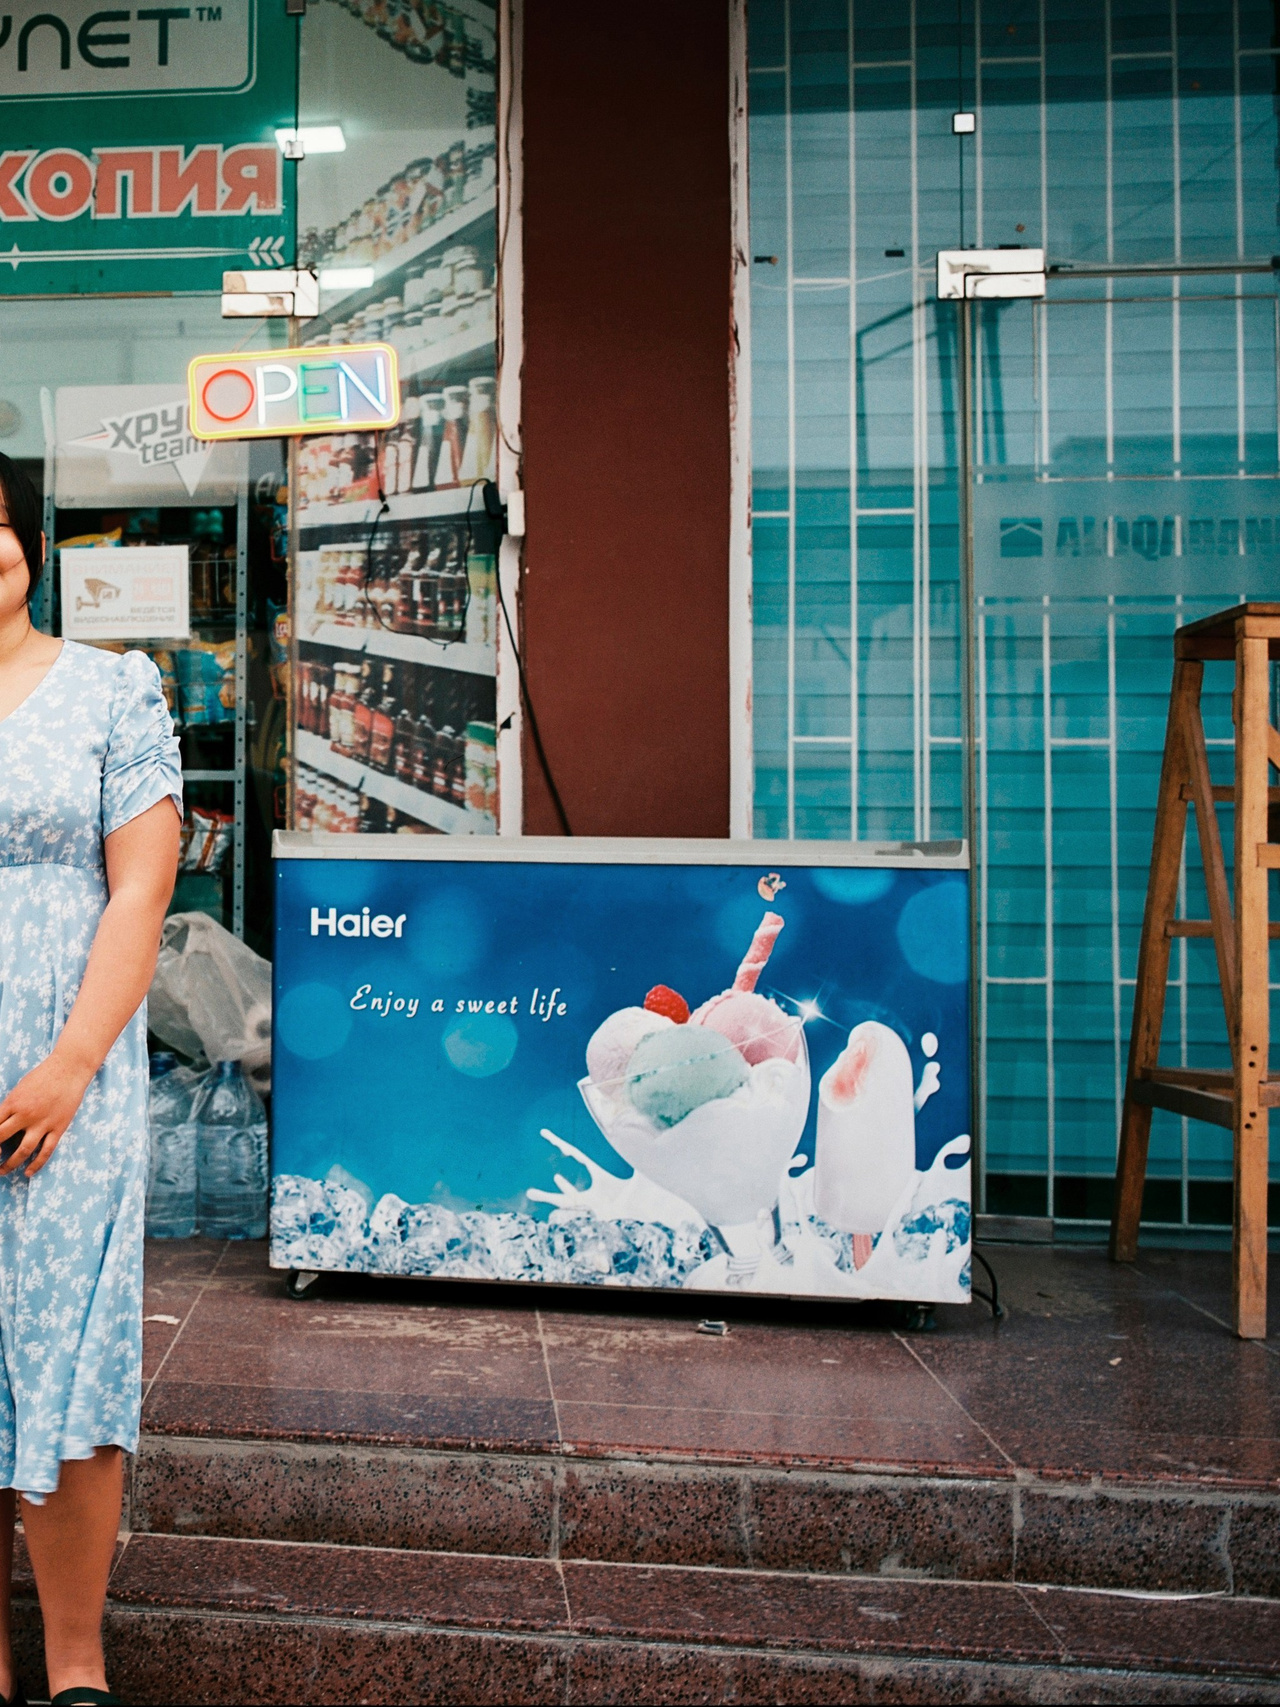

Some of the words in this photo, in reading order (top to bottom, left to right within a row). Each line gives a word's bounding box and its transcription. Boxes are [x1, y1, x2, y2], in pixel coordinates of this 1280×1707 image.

[202, 355, 387, 426] OPEN
[108, 405, 186, 449] ХРУ
[310, 906, 407, 938] Haier
[349, 984, 420, 1018] Enjoy
[431, 999, 444, 1013] a
[455, 996, 519, 1015] sweet
[530, 988, 568, 1022] life
